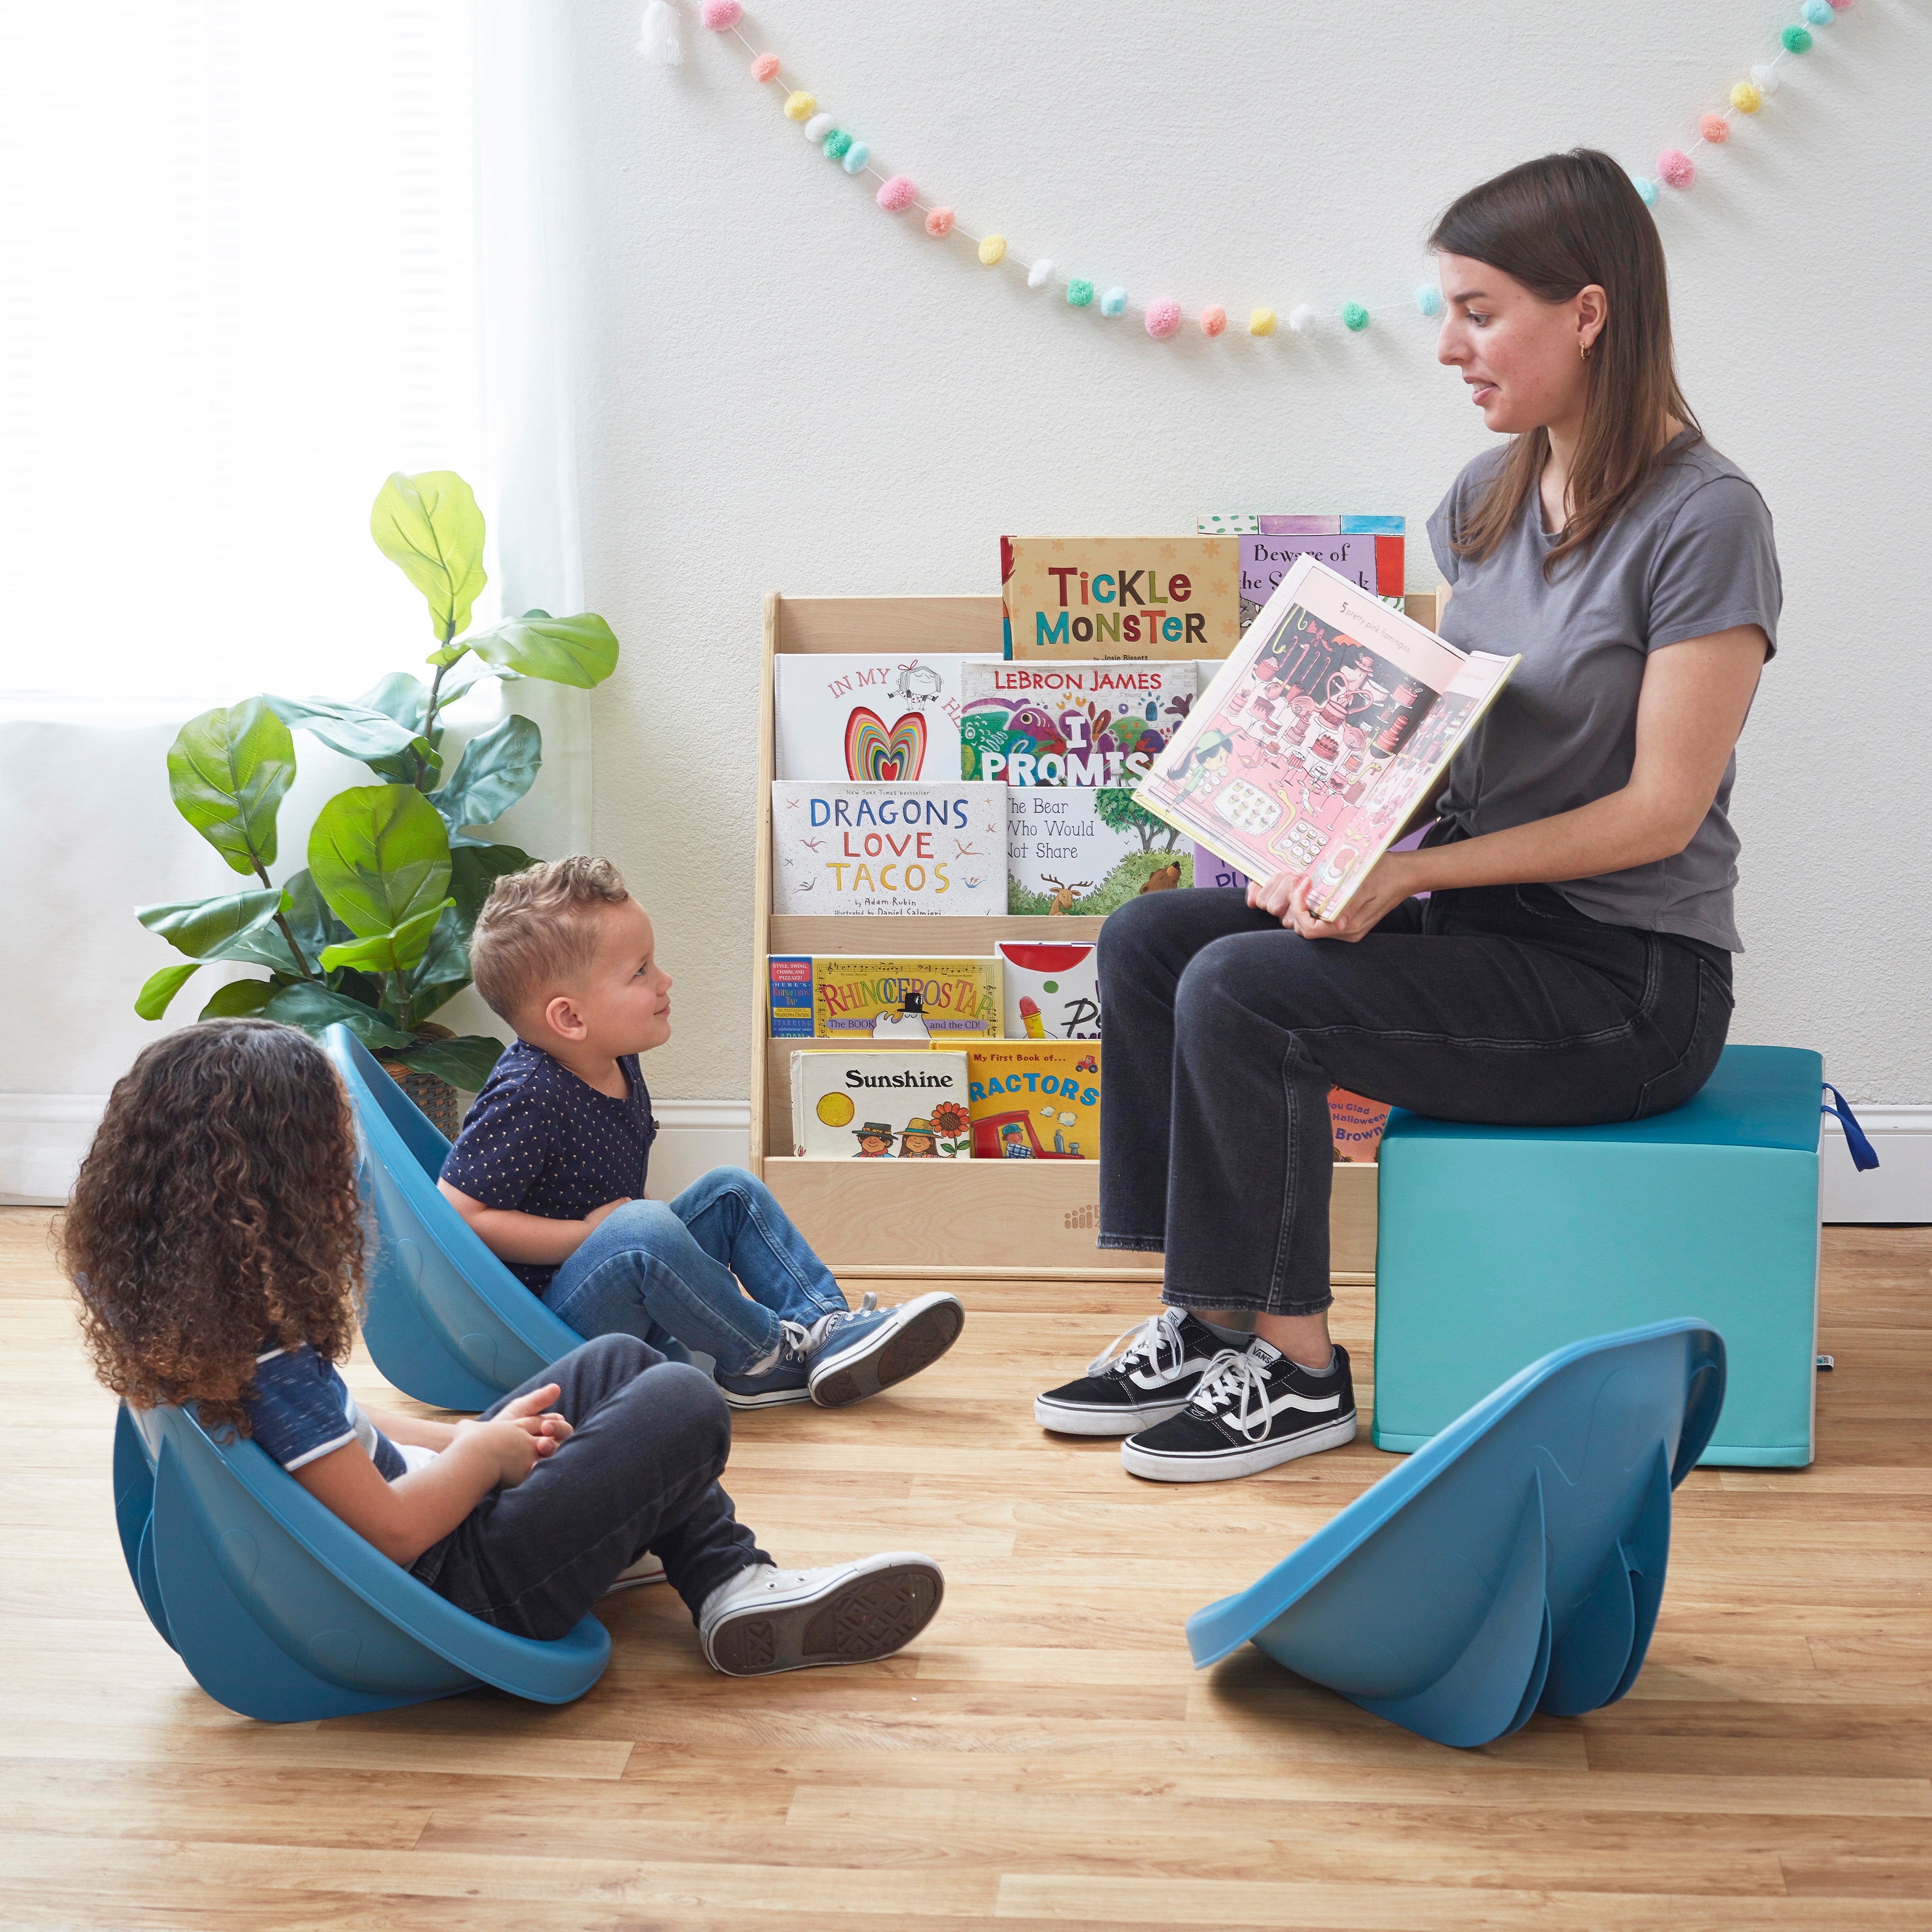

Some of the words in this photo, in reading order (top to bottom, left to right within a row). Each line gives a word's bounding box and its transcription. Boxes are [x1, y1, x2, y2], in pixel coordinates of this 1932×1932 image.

[1330, 543, 1350, 561] of
[1340, 602, 1348, 612] 5
[1346, 610, 1366, 625] pretty
[1366, 622, 1379, 634] pink
[1381, 629, 1410, 653] flamingos
[827, 675, 853, 699] IN
[855, 668, 891, 687] MY
[995, 671, 1083, 690] LEBRON
[1090, 670, 1162, 691] JAMES
[1065, 716, 1086, 749] I
[810, 798, 969, 829] DRAGONS
[1034, 798, 1069, 813] Bear
[1008, 821, 1037, 836] Who
[1044, 821, 1094, 836] Would
[844, 832, 934, 858] LOVE
[1036, 843, 1078, 858] Share
[826, 863, 950, 894] TACOS
[893, 897, 916, 906] Rubin
[785, 996, 797, 1005] TAP
[954, 979, 994, 1019] TAP
[849, 1020, 875, 1028] BOOK
[974, 1054, 987, 1062] My
[845, 1069, 953, 1089] Sunshine
[1346, 1103, 1370, 1115] Glad
[1335, 1122, 1386, 1141] Brown
[1252, 1346, 1273, 1364] VANS
